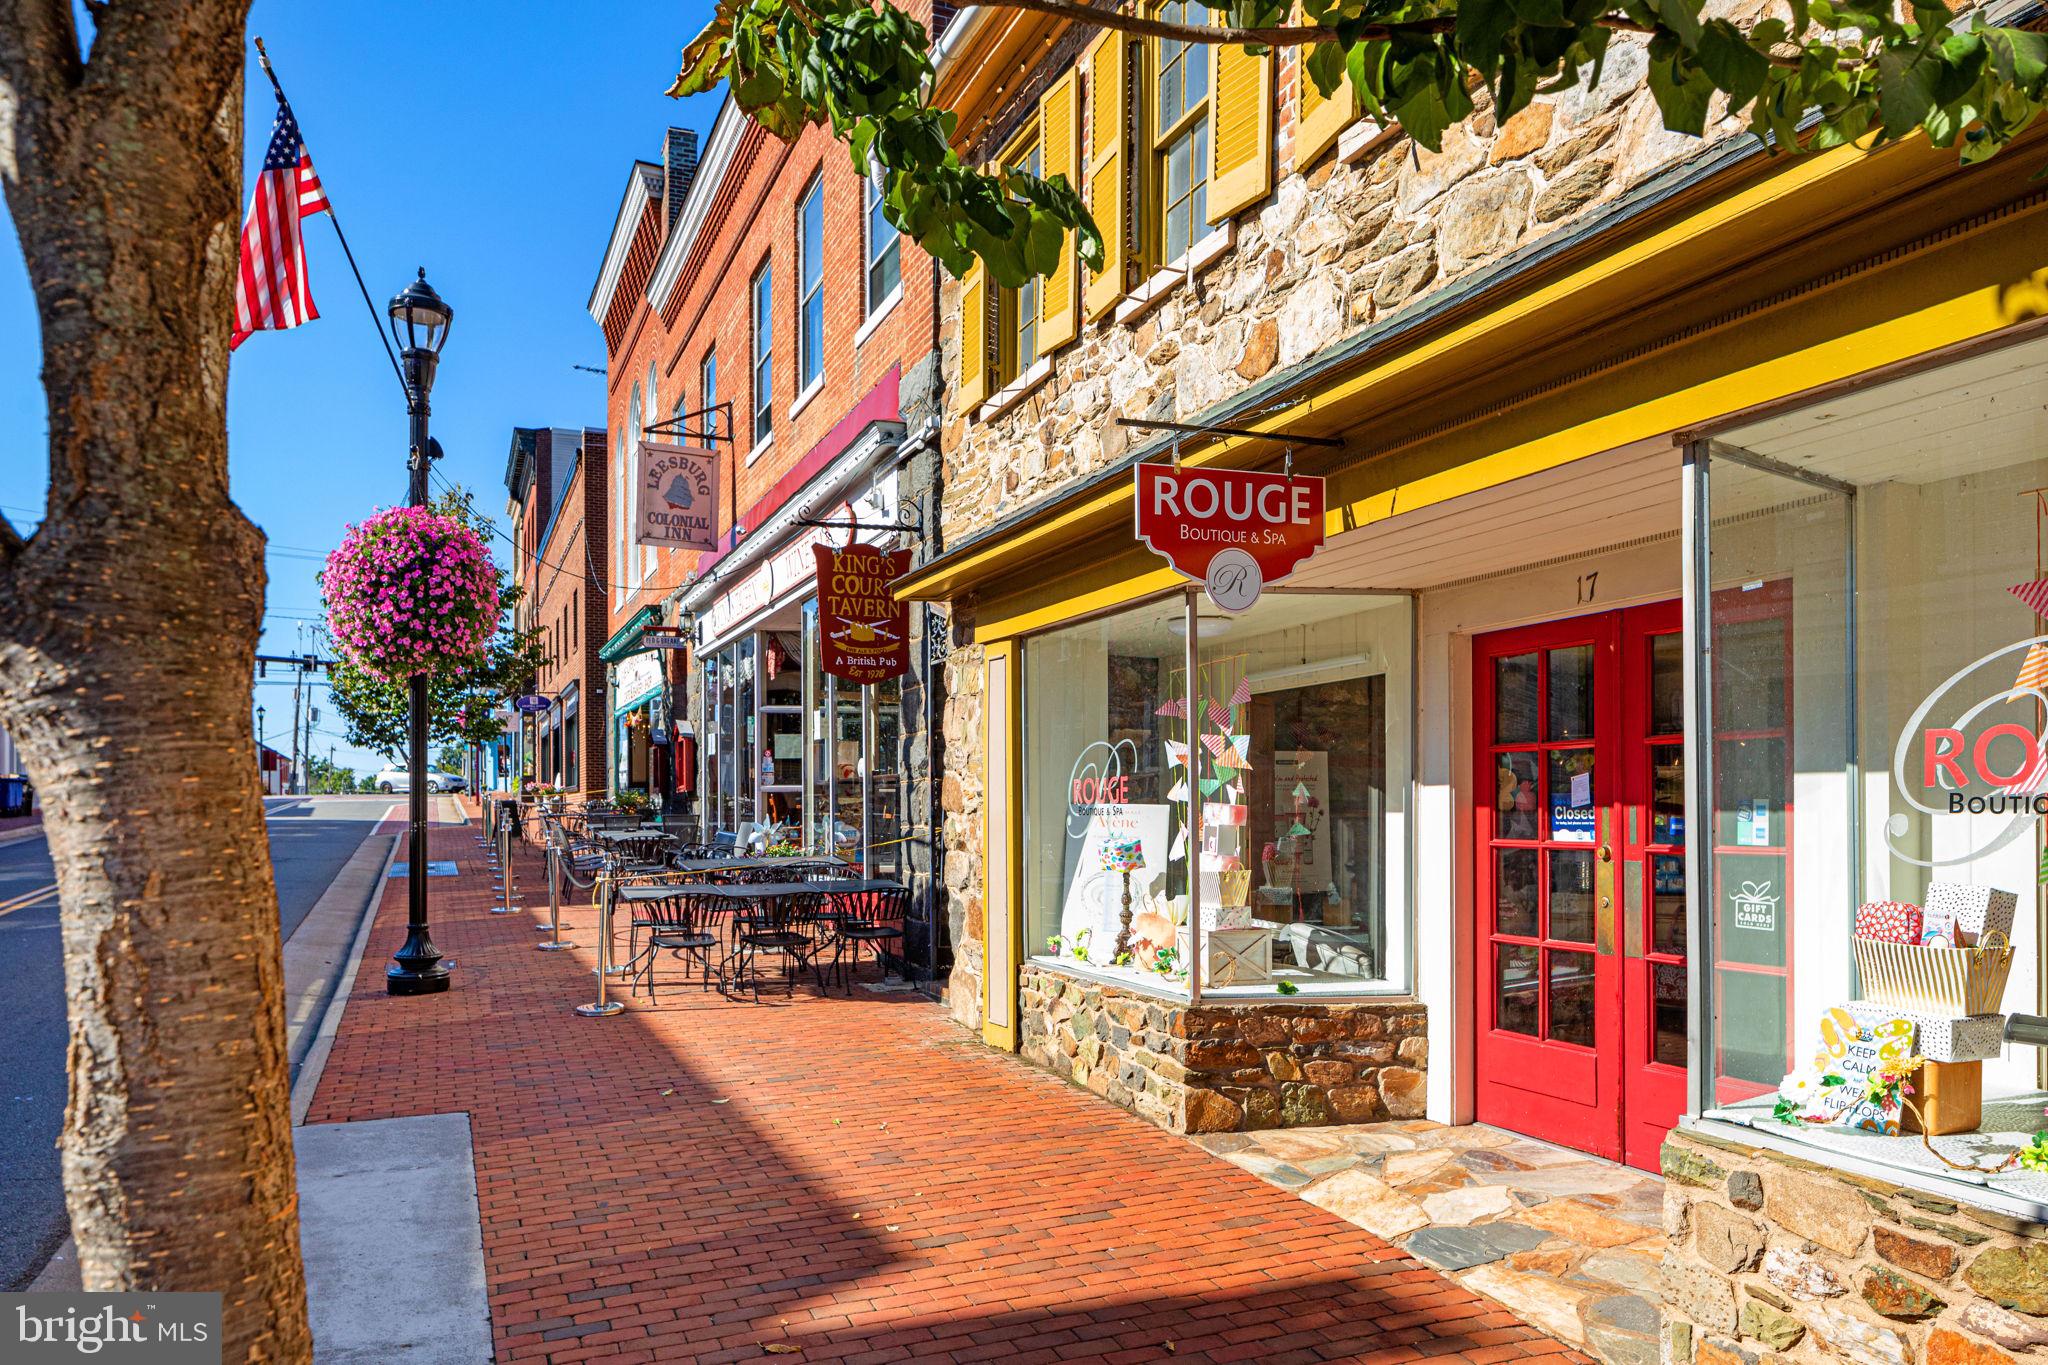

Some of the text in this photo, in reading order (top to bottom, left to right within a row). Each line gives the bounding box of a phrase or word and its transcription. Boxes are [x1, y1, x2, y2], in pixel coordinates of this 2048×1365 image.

[647, 456, 710, 496] LEESBURG
[1154, 475, 1311, 525] ROUGE
[647, 511, 709, 529] COLONIAL
[664, 526, 692, 541] INN
[1251, 532, 1260, 544] &
[832, 554, 896, 576] KING'S
[831, 575, 895, 598] COURT
[1213, 563, 1258, 598] R
[1576, 571, 1599, 604] 17
[827, 596, 901, 618] TAVERN
[835, 655, 897, 667] A British Pub
[1073, 775, 1129, 805] ROUGE
[1554, 805, 1595, 820] Closed
[1743, 903, 1767, 914] GIFT
[1738, 912, 1772, 924] CARDS
[1848, 1044, 1876, 1060] KEEP
[1842, 1060, 1877, 1073] CALM
[1839, 1085, 1866, 1099] WEA
[1824, 1097, 1846, 1110] FLIP
